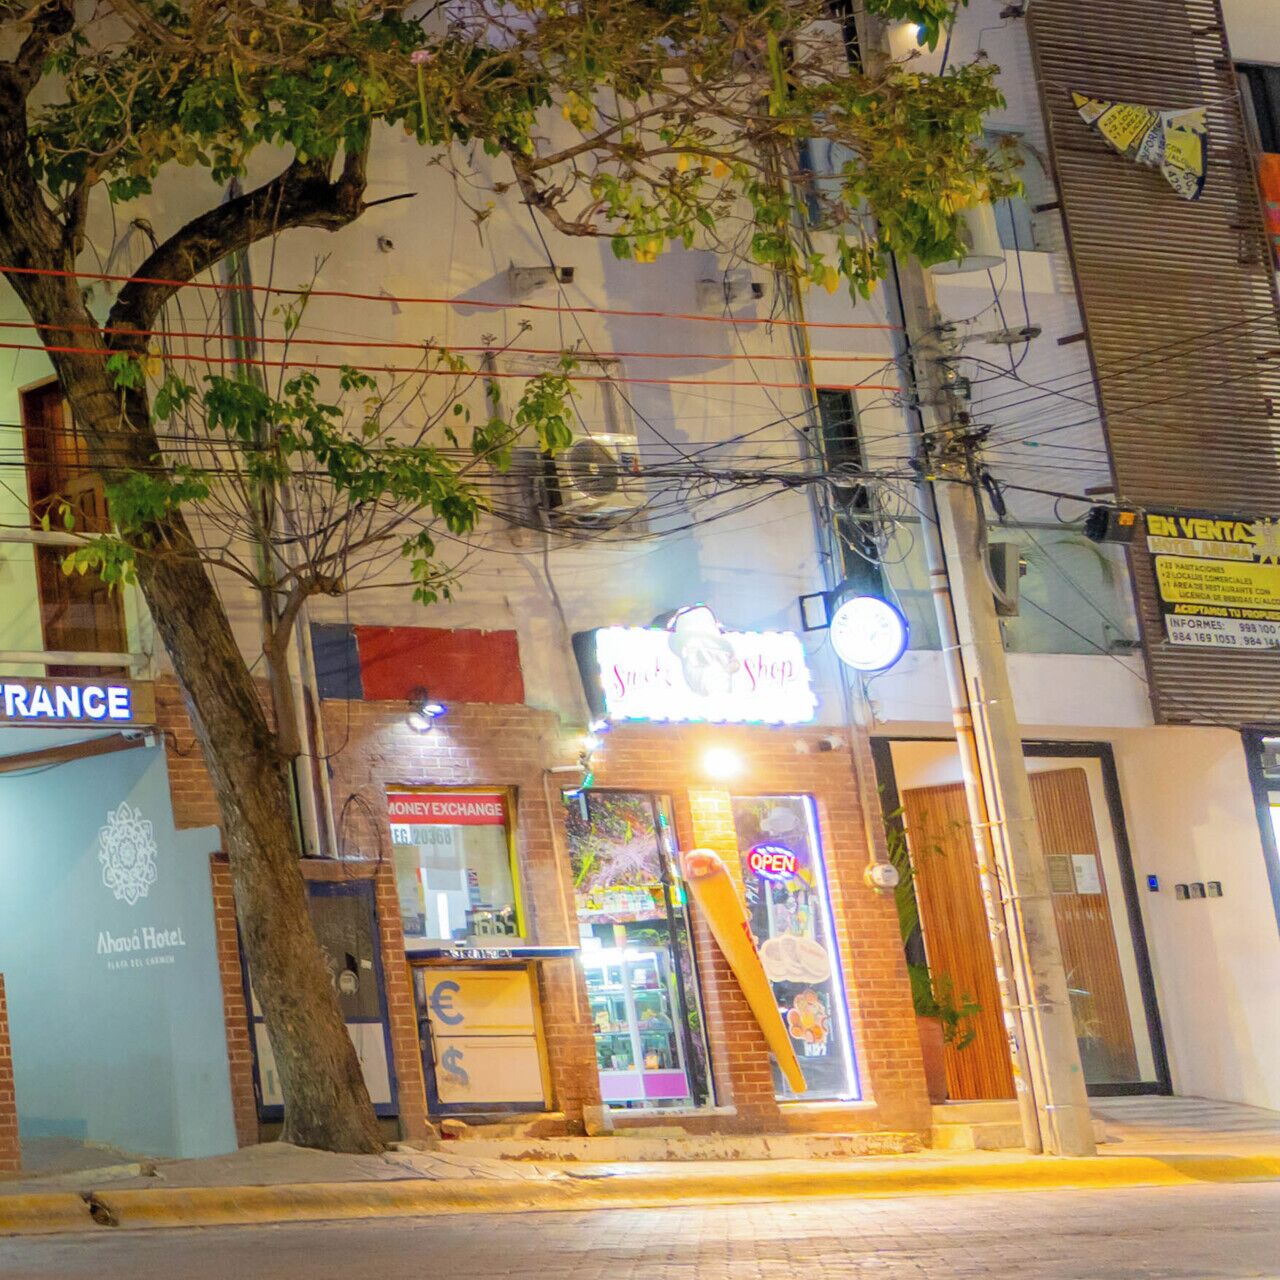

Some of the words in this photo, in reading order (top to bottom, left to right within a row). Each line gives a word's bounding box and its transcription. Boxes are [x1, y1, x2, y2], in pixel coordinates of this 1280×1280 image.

[1146, 515, 1178, 537] EN
[1179, 518, 1255, 542] VENTA
[389, 802, 430, 816] MONEY
[432, 803, 503, 816] EXCHANGE
[750, 853, 795, 872] OPEN
[96, 928, 140, 954] Ahavá
